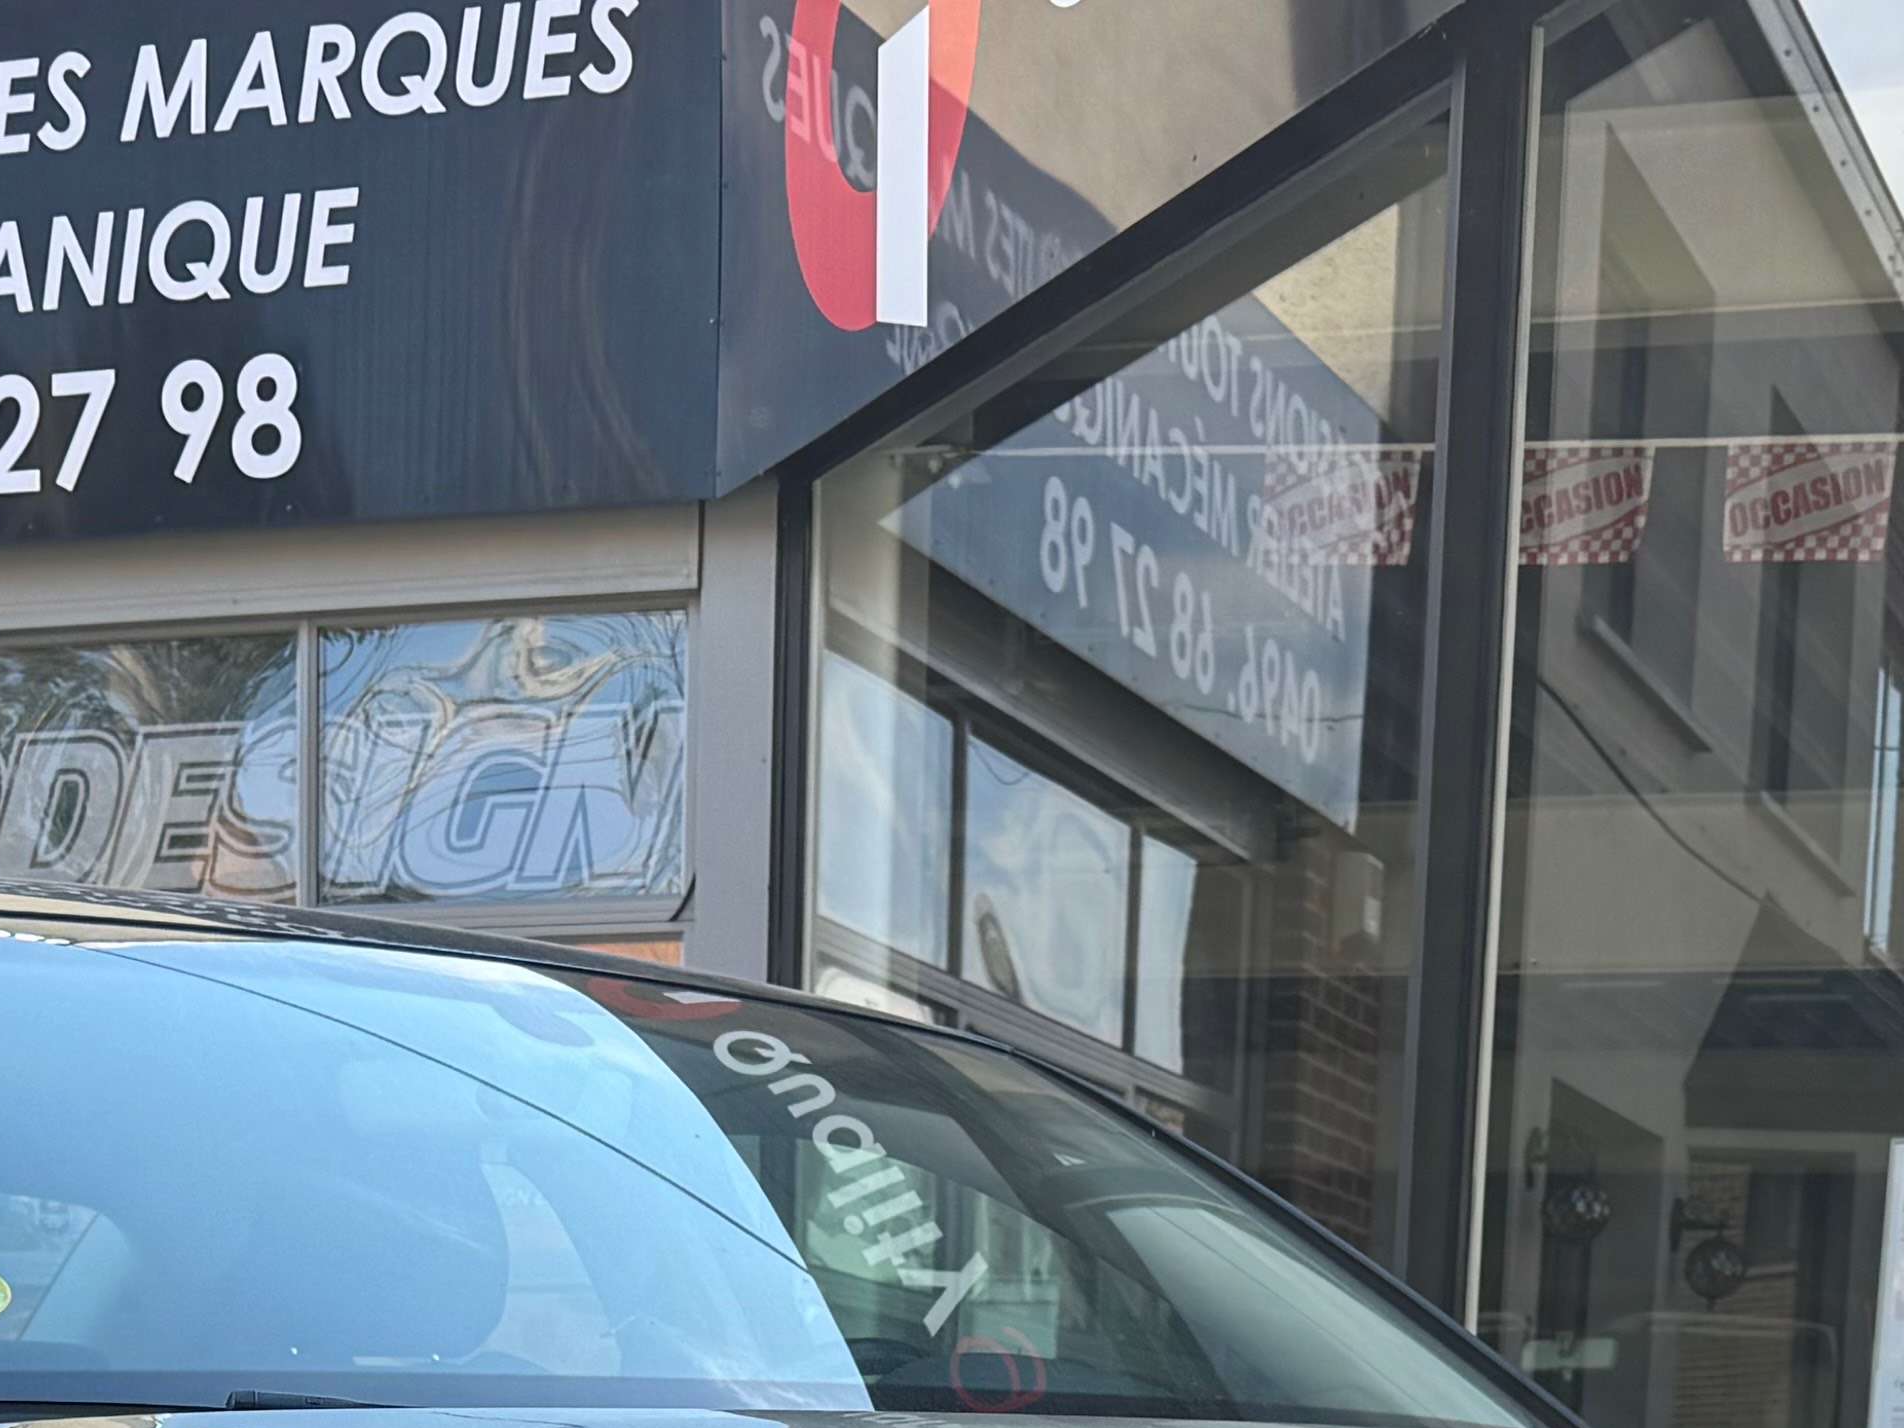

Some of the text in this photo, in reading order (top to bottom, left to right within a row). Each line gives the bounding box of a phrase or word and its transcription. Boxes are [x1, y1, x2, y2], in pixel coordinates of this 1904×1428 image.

[120, 0, 639, 142] MARQUES
[161, 353, 302, 485] 98
[1730, 457, 1886, 538] OCCASION
